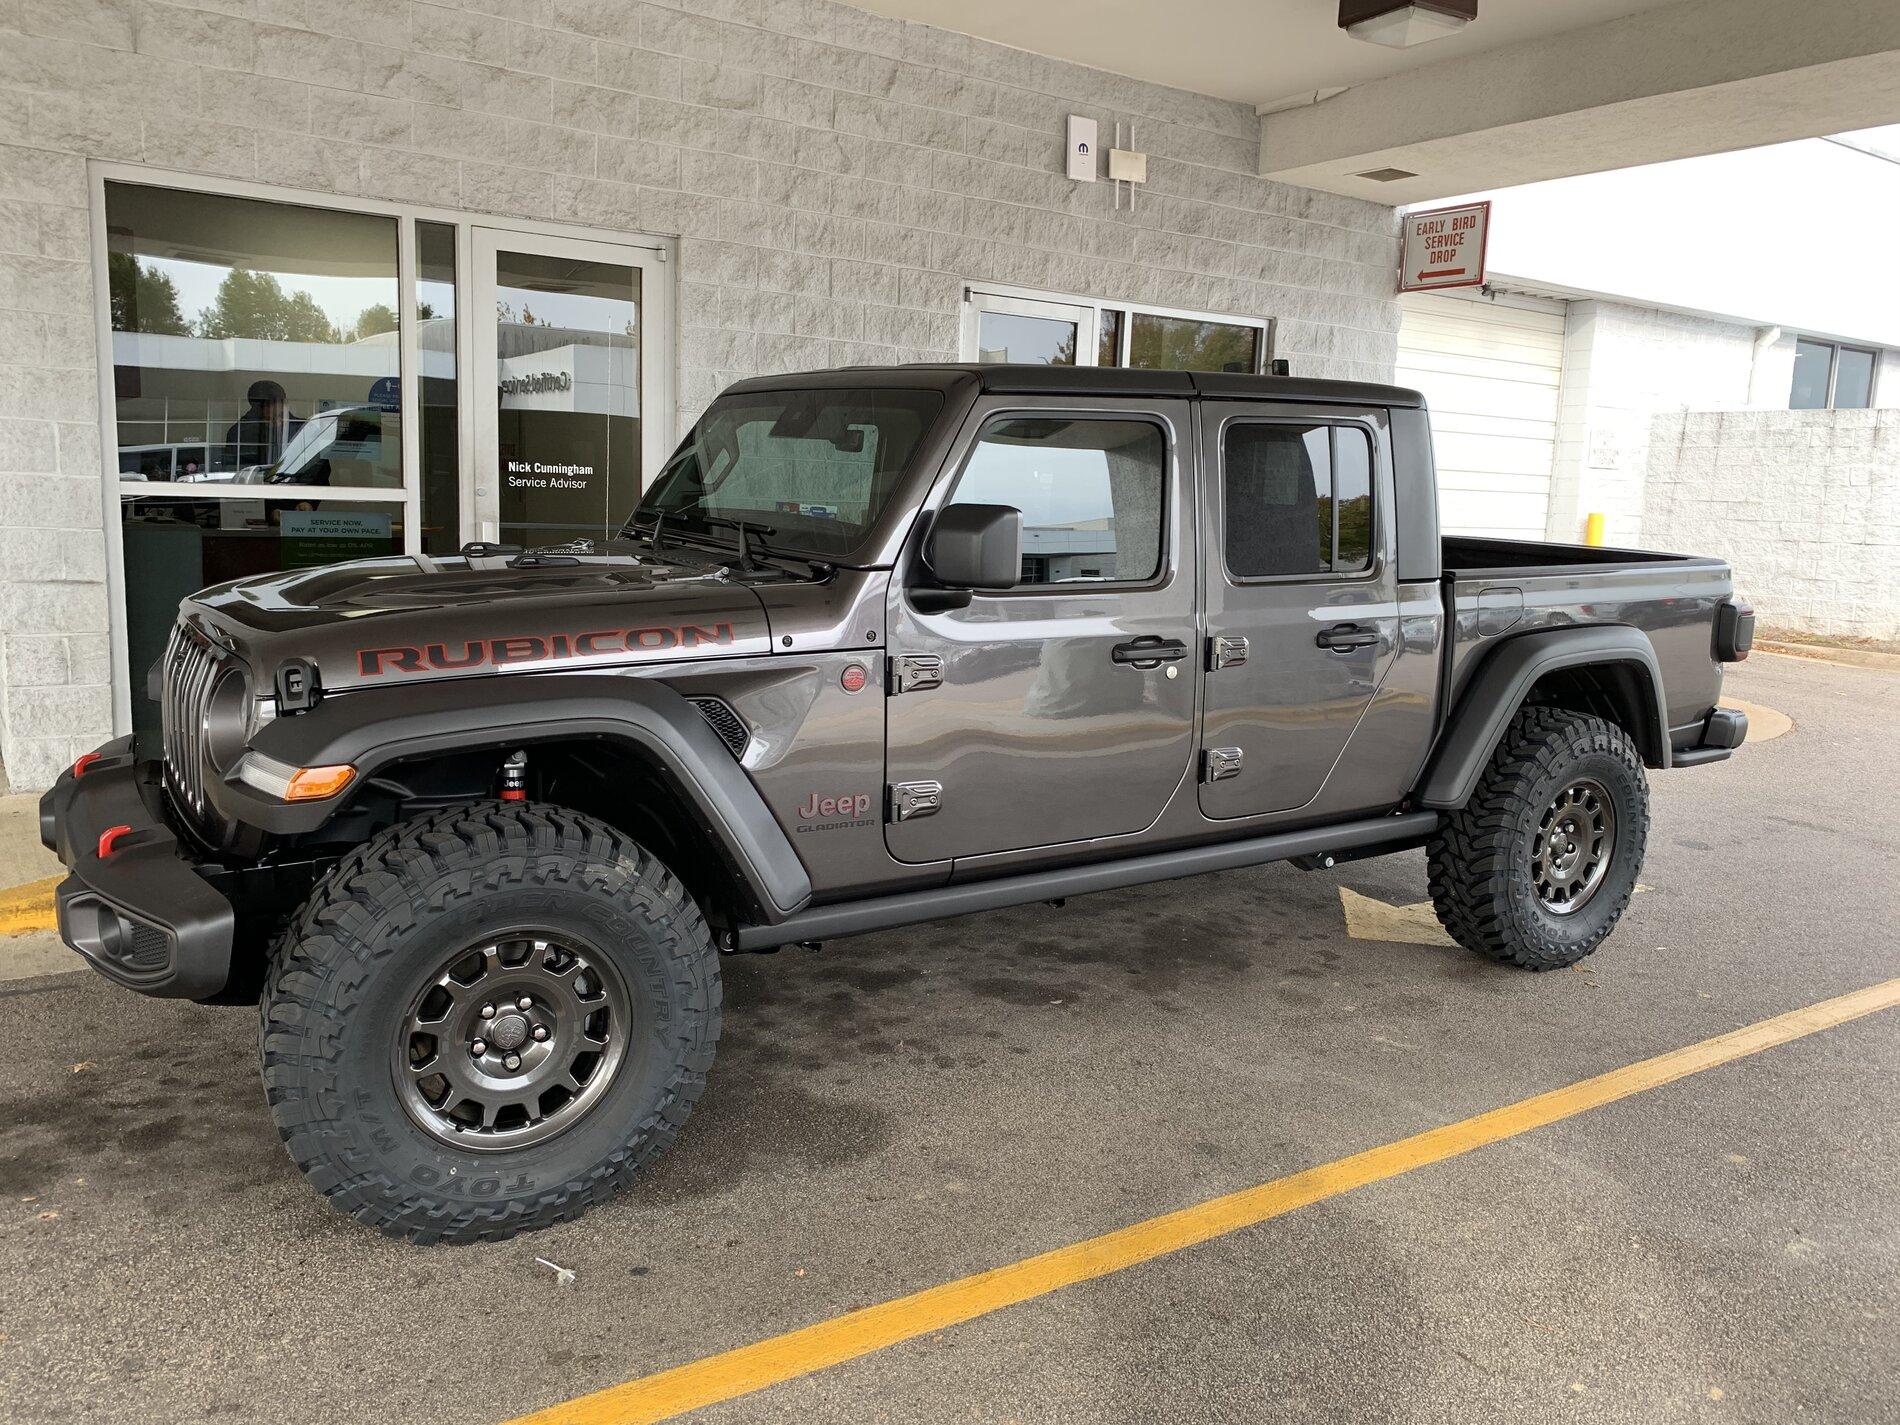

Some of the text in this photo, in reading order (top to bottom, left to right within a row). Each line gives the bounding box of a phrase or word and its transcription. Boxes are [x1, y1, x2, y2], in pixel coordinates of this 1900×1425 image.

[1416, 216, 1476, 235] EARLY BIRD
[1424, 232, 1465, 249] SERVICE
[1430, 249, 1456, 264] DROP
[508, 461, 593, 476] Nick Cunningham
[508, 476, 587, 489] Service Advisor
[356, 622, 734, 677] RUBICON
[503, 779, 524, 788] Jeep
[798, 792, 871, 820] Jeep
[796, 819, 875, 834] GLADIATOR
[580, 901, 673, 1051] COUNTRY
[408, 1163, 536, 1198] TOYO
